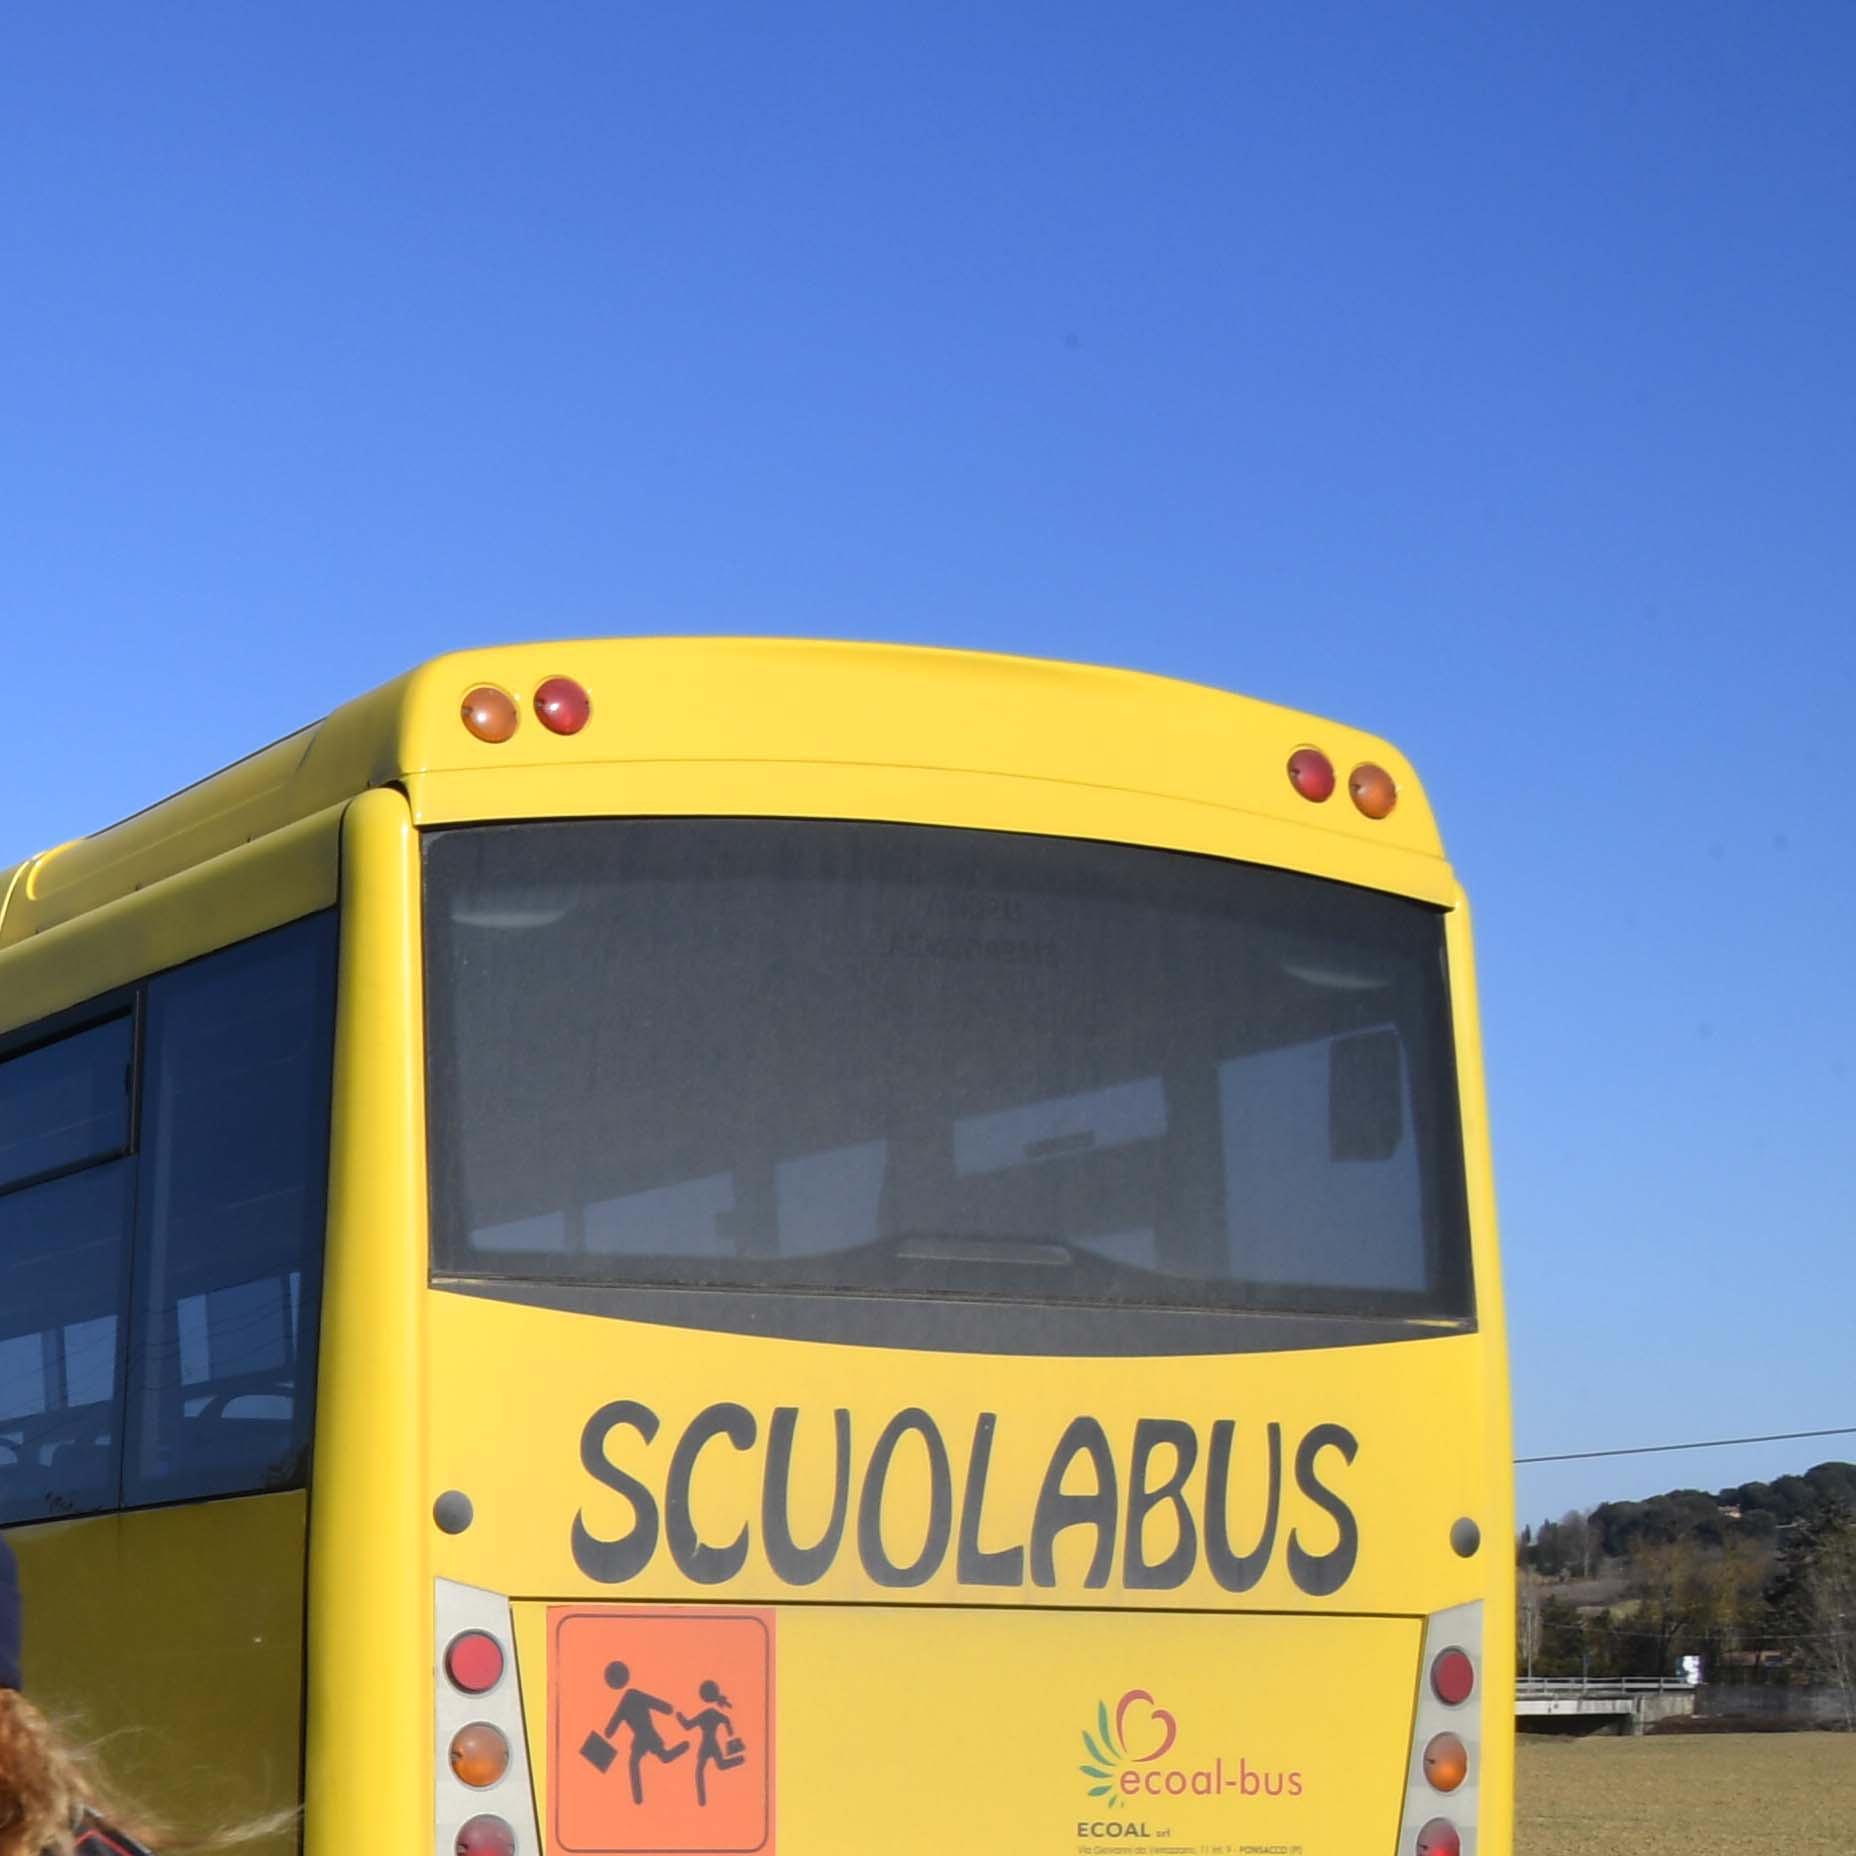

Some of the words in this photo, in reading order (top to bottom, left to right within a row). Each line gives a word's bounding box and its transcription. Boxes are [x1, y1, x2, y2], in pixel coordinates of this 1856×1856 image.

[571, 1399, 1359, 1596] SCUOLABUS
[1119, 1757, 1303, 1796] ecoal-bus
[1076, 1822, 1151, 1838] ECOAL
